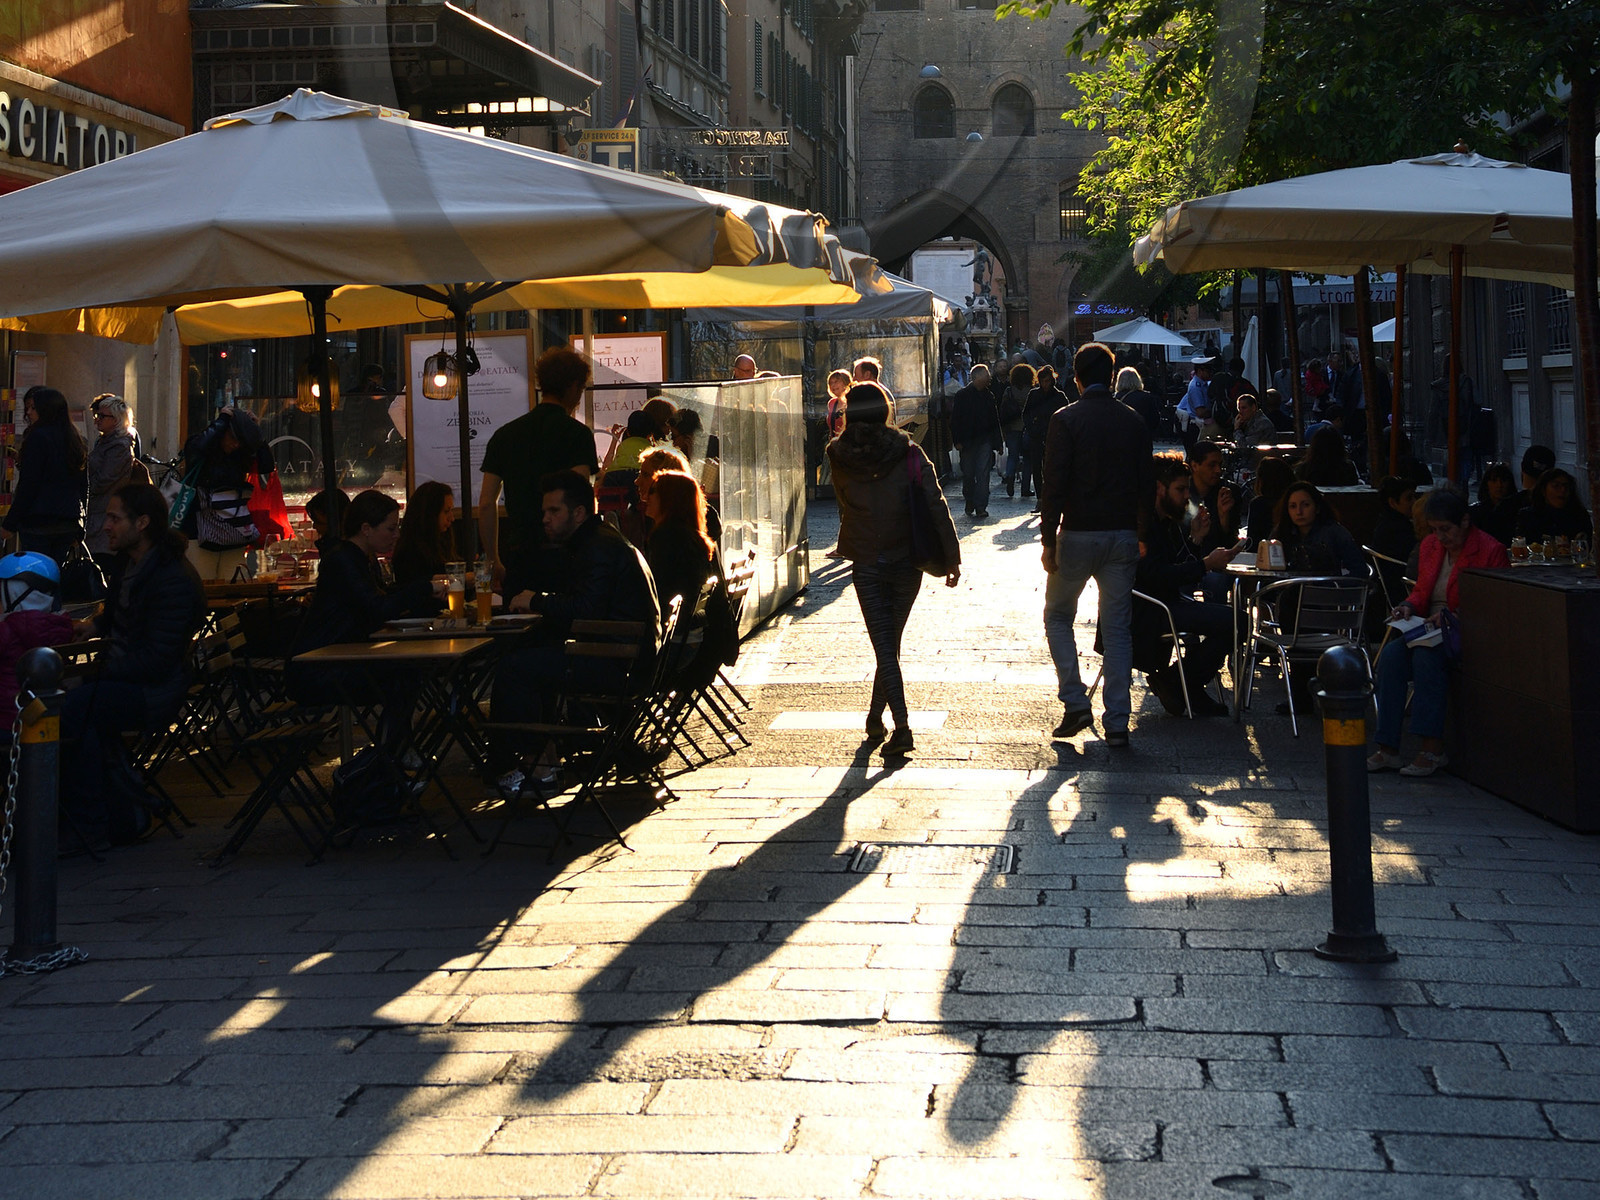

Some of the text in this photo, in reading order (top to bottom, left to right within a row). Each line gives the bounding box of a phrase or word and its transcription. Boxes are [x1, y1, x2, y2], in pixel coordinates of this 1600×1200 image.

[592, 132, 619, 140] SERVICE
[621, 132, 629, 140] 24
[596, 145, 632, 170] T
[599, 357, 639, 368] ITALY
[594, 399, 647, 412] EATALY
[446, 417, 492, 427] ZEBINA
[274, 460, 357, 474] ATALY
